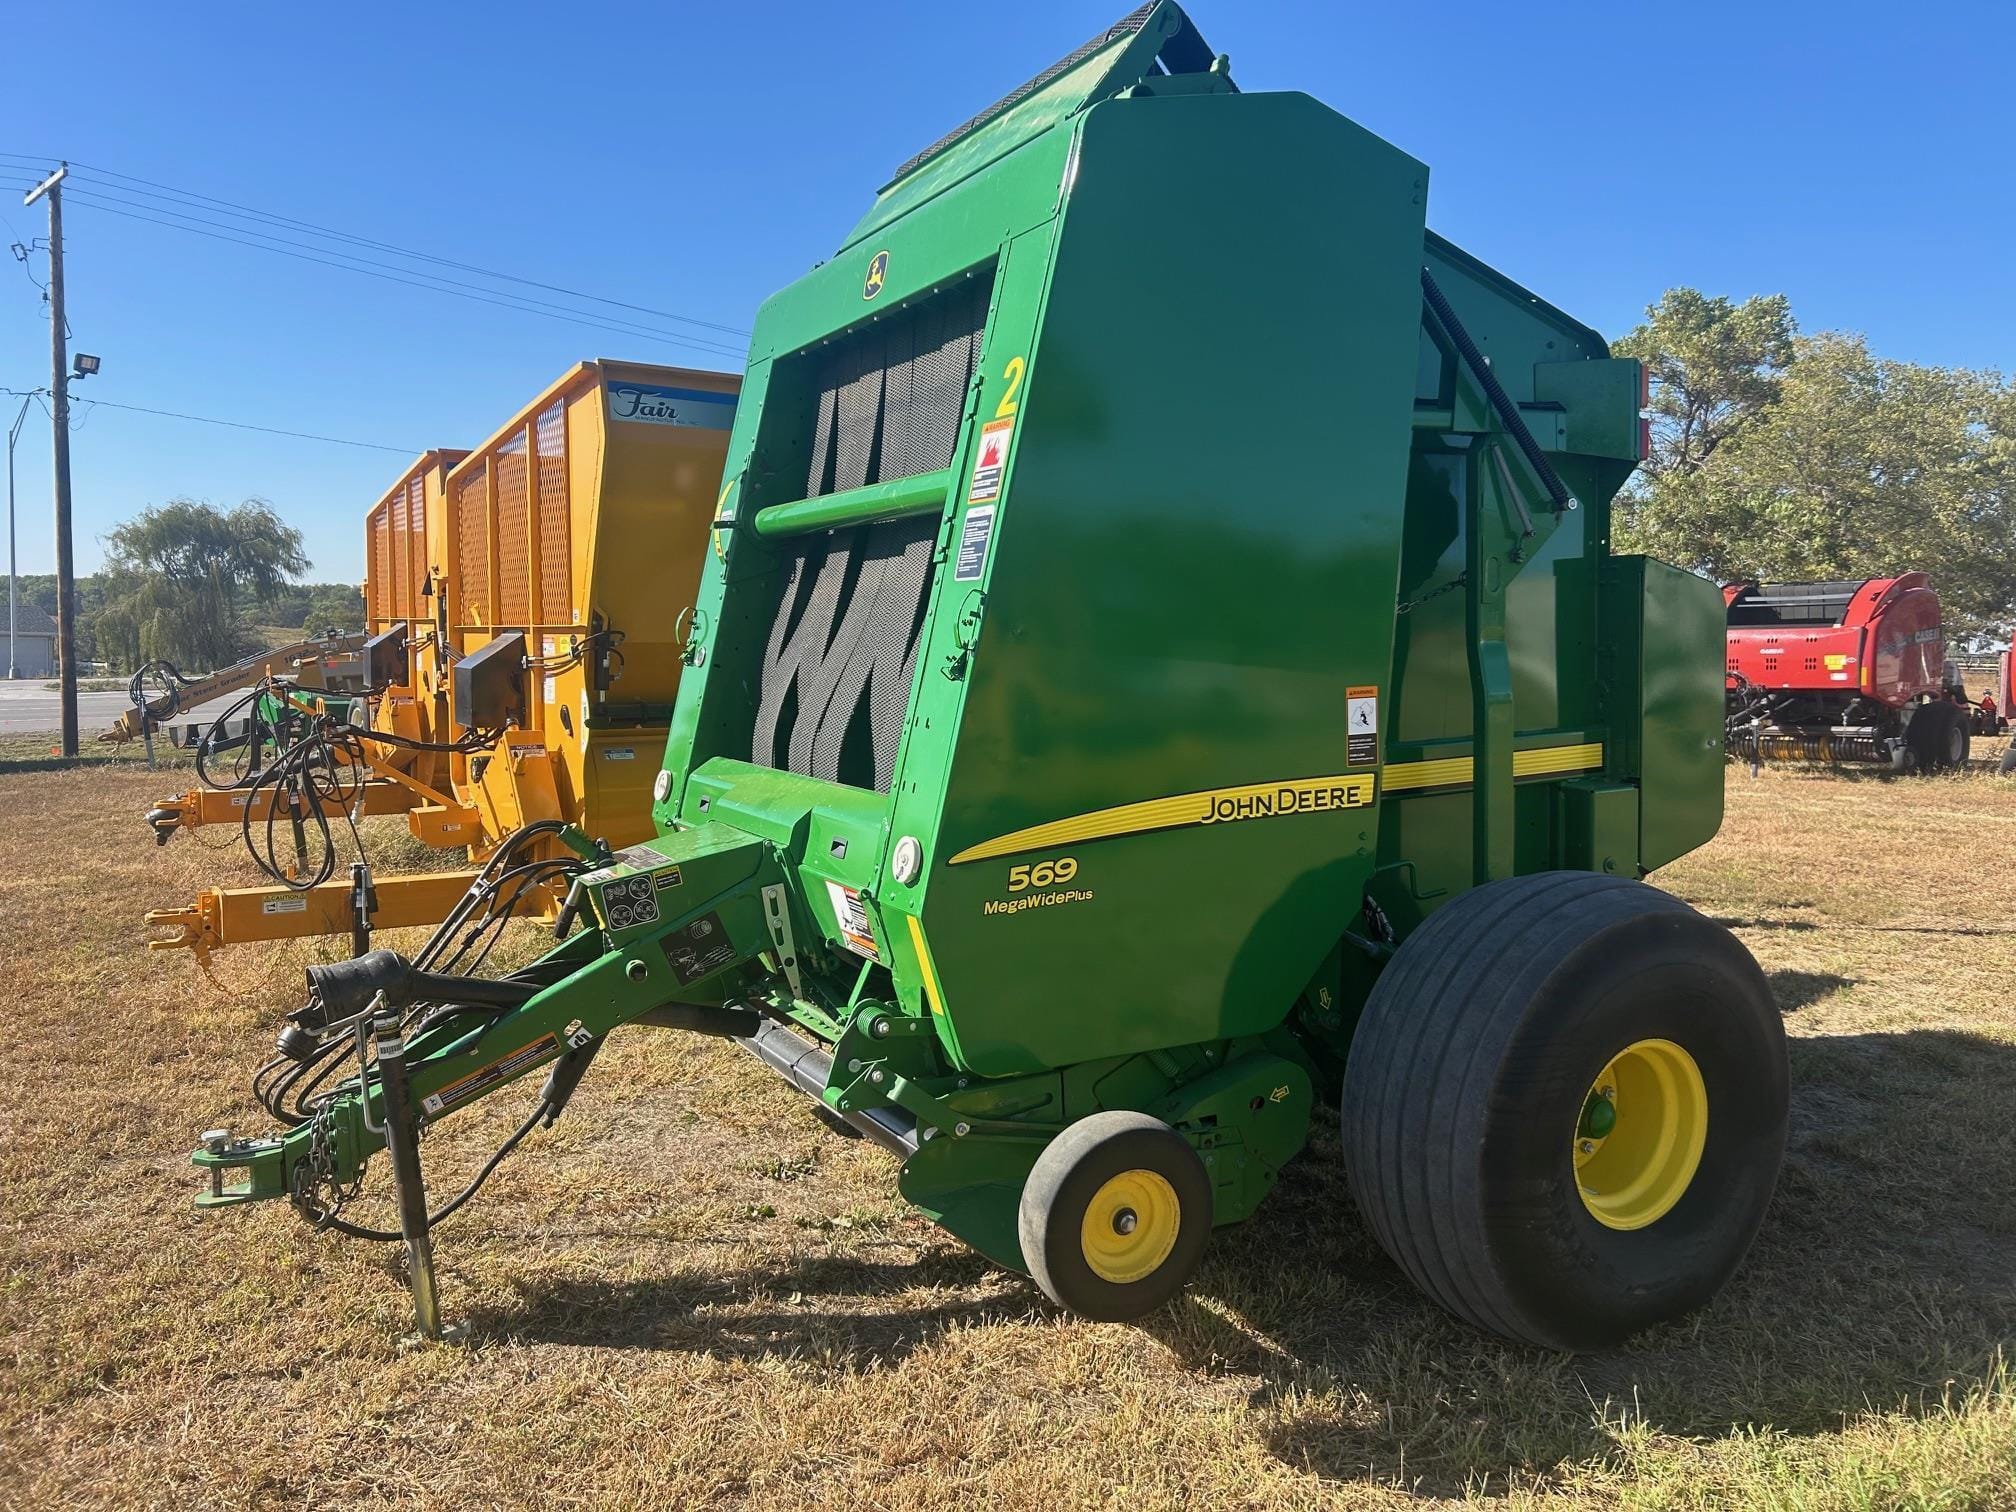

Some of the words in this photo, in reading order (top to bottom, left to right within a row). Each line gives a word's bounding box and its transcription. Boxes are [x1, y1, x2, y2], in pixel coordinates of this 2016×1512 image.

[613, 389, 679, 419] Fair
[995, 356, 1024, 418] 2
[1201, 794, 1272, 822] JOHN
[1278, 785, 1361, 812] DEERE
[1008, 856, 1078, 892] 569
[984, 889, 1094, 916] MegaWidePlus
